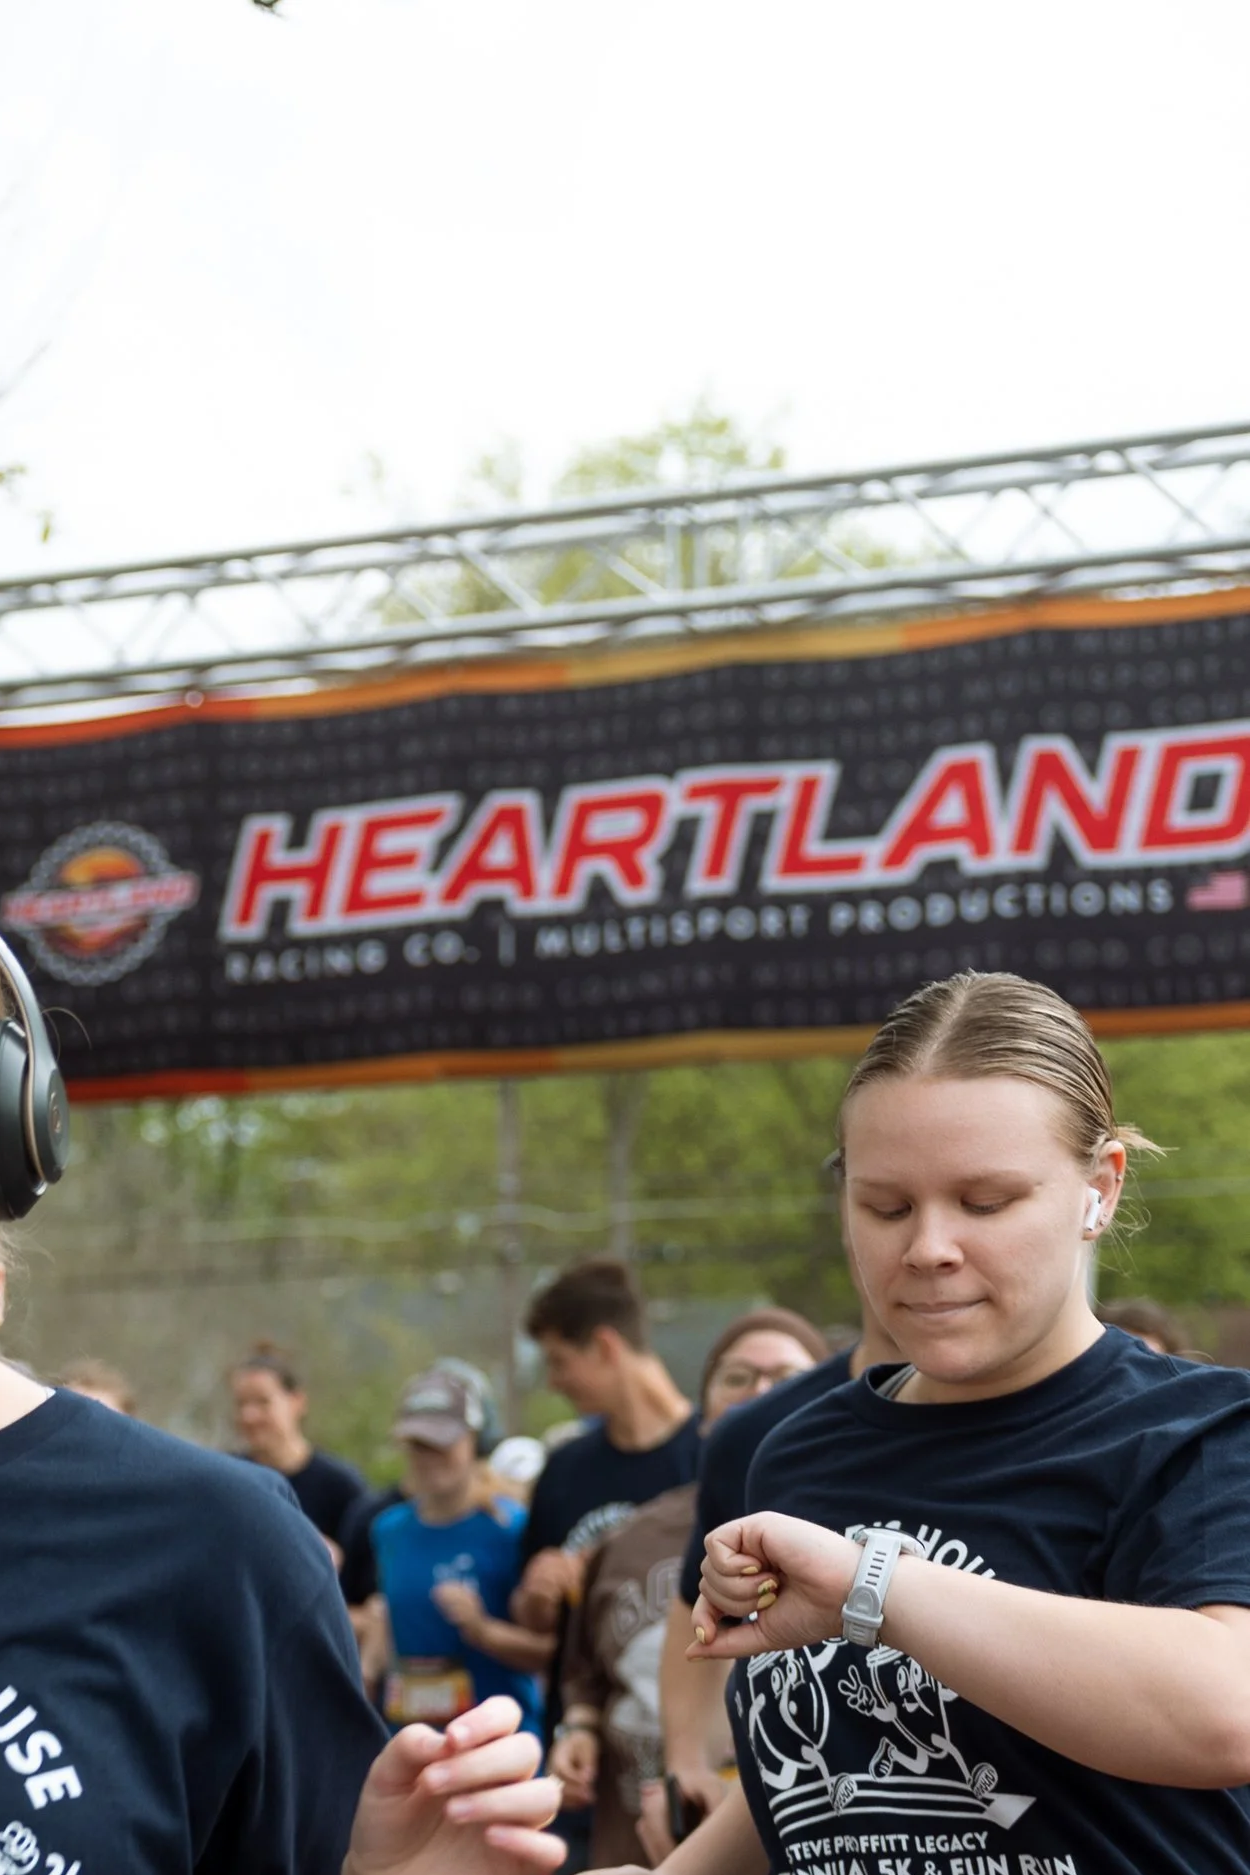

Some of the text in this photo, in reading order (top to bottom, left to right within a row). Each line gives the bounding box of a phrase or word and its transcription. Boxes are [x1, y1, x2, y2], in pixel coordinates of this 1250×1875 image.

[218, 722, 1250, 943] HEARTLAND
[224, 937, 389, 984] RACING
[534, 904, 811, 958] MULTISPORT
[828, 877, 1175, 937] PRODUCTIONS
[914, 1831, 989, 1854] LEGACY
